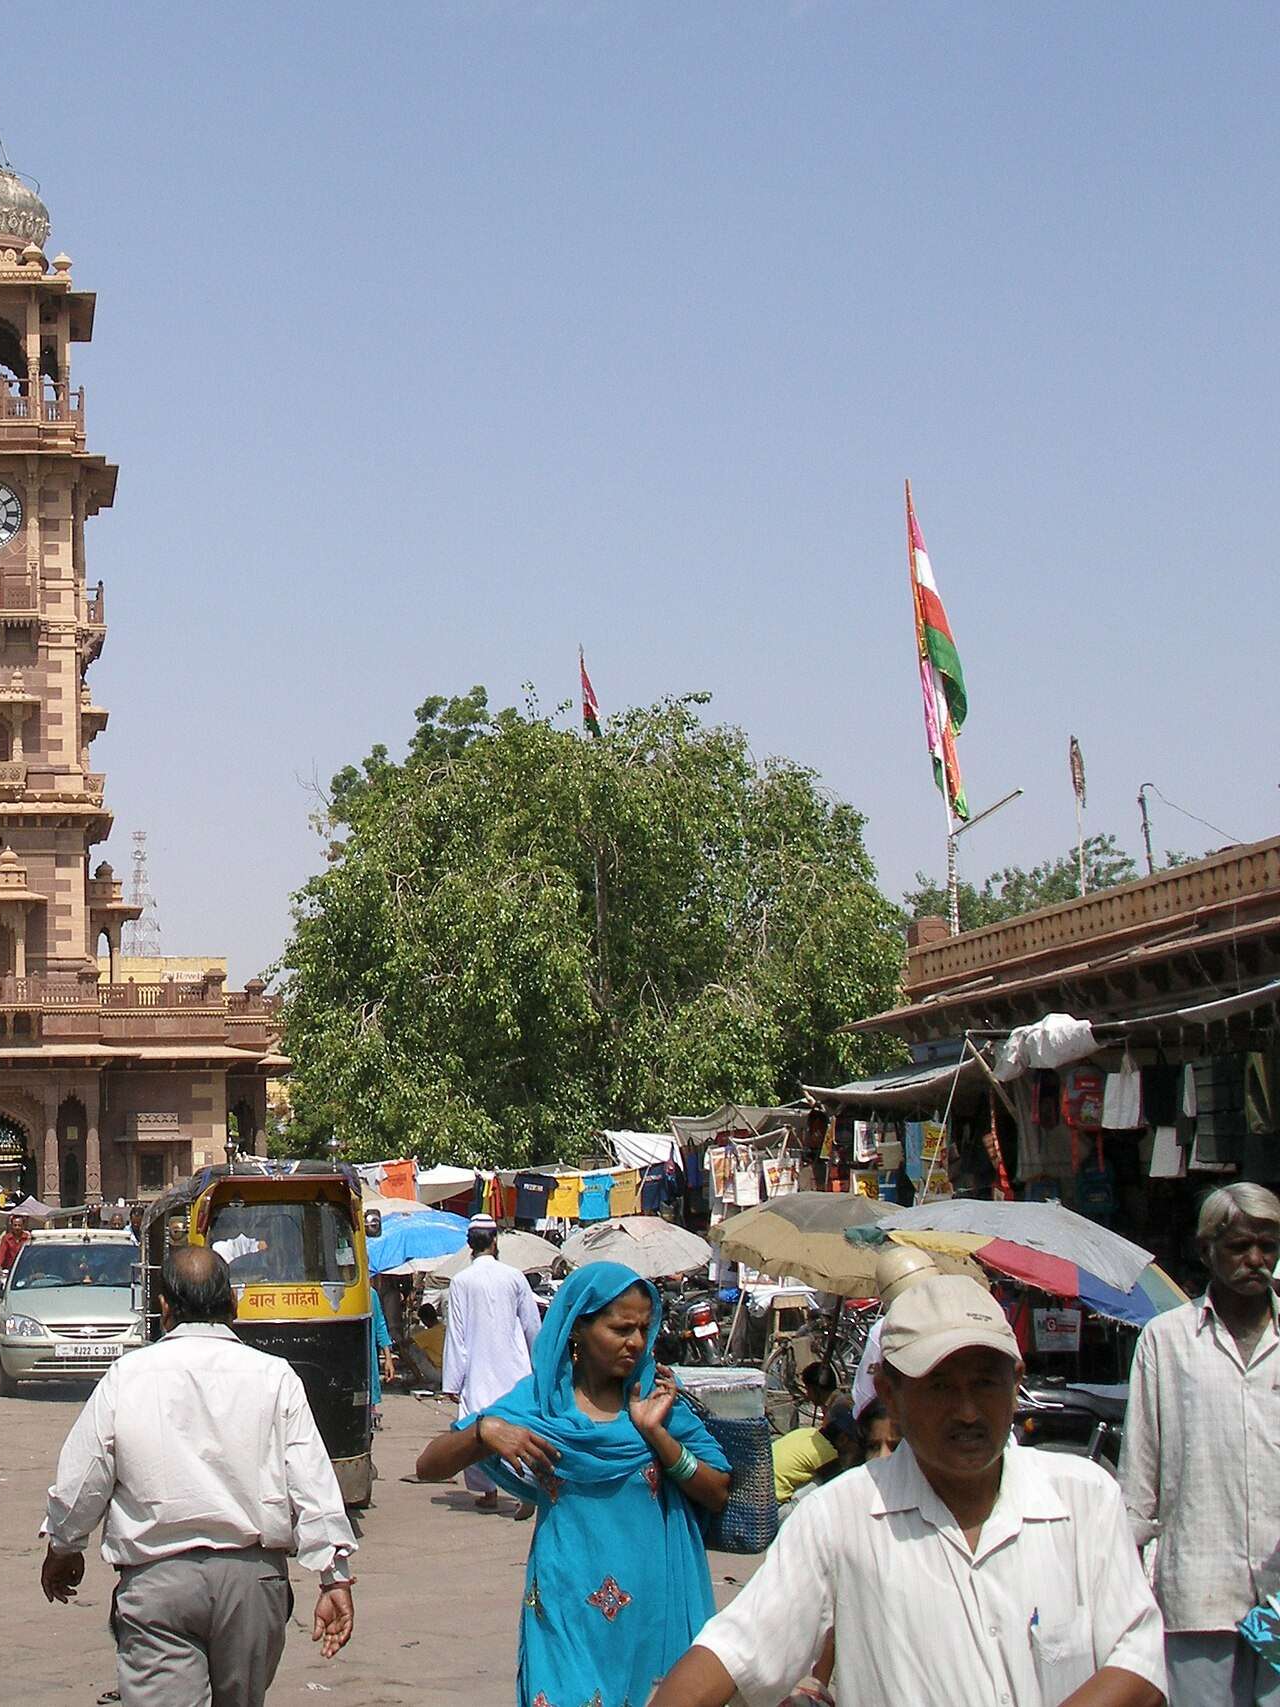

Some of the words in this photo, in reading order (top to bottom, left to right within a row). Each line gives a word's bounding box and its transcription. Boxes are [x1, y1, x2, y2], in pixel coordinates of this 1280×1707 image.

[248, 1293, 276, 1309] बाल
[74, 1347, 91, 1355] RJ22
[95, 1347, 99, 1355] C
